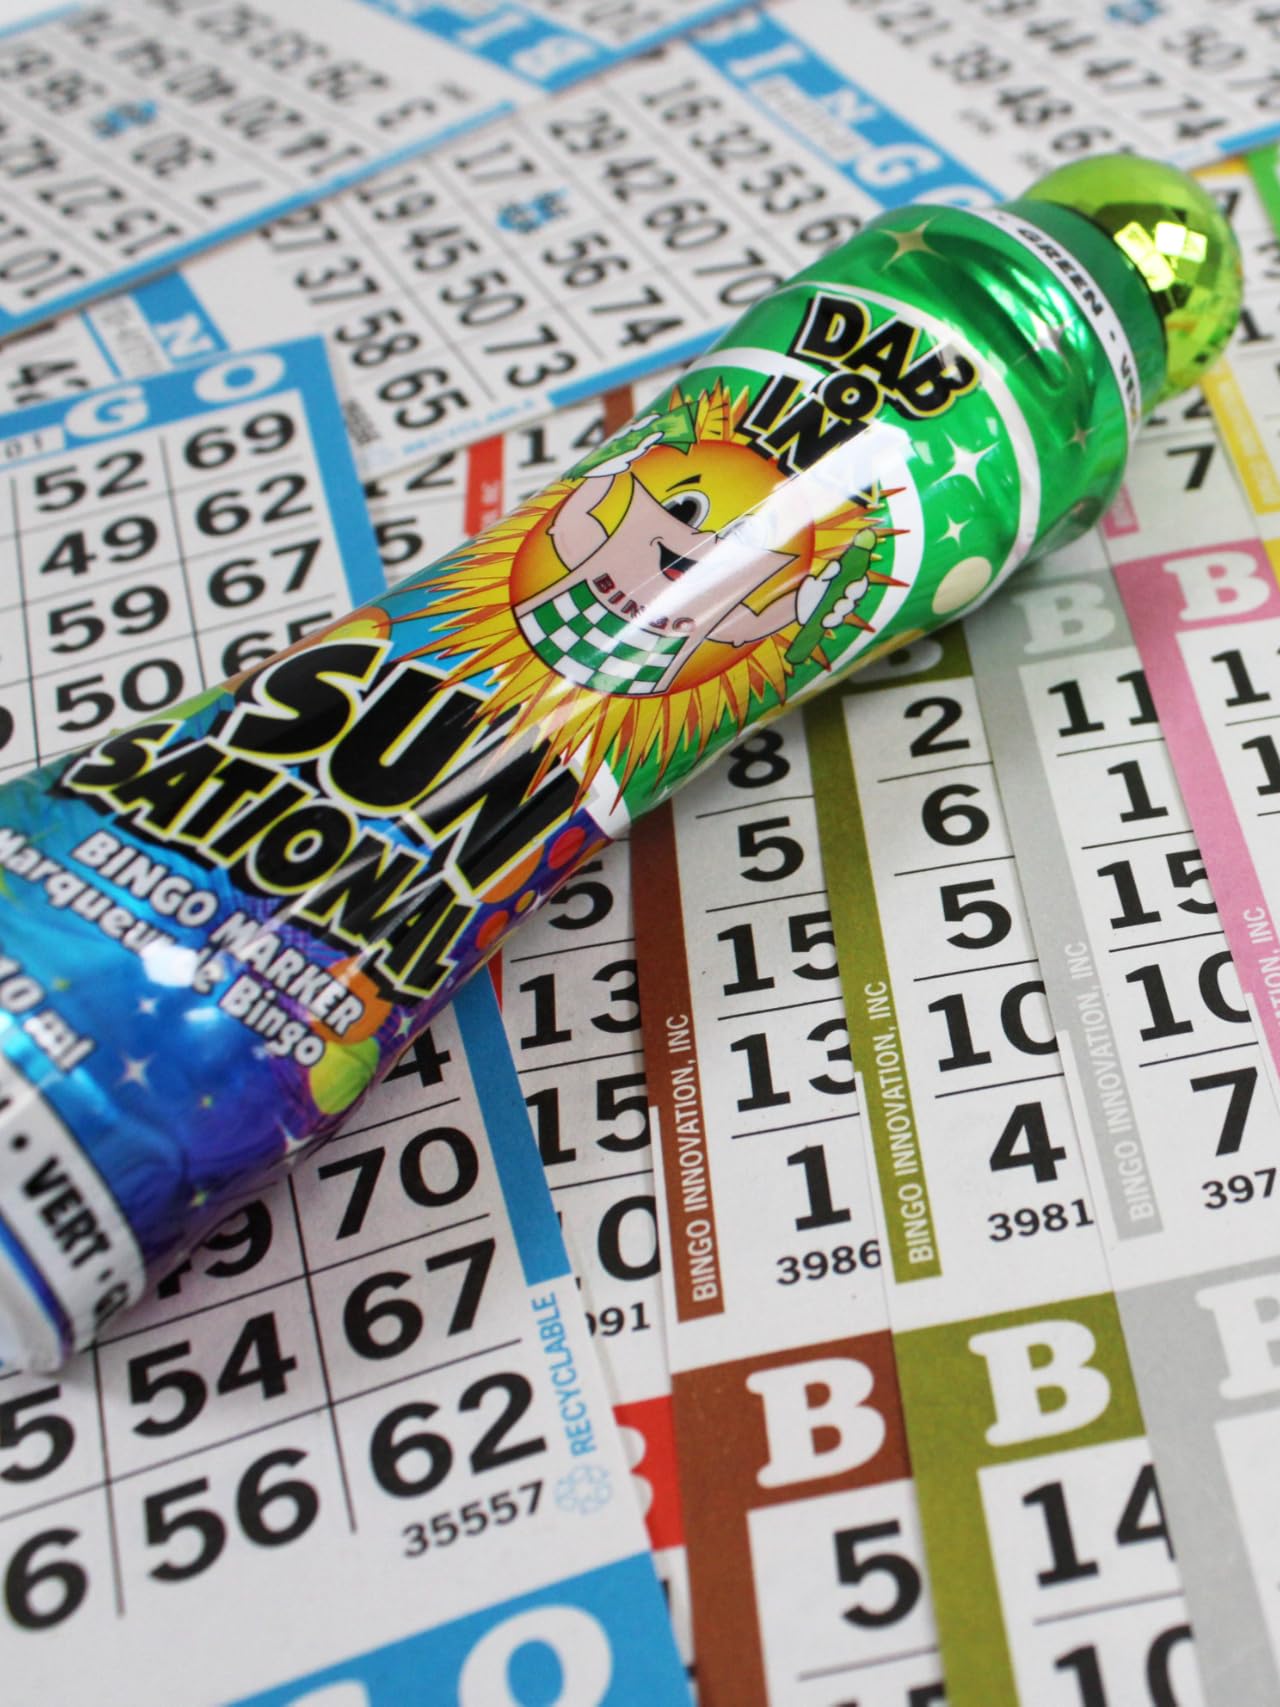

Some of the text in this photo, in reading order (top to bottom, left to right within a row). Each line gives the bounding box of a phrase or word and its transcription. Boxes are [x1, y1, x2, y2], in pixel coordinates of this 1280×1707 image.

[295, 255, 381, 305] 37
[335, 162, 826, 370] 58 50 56 53
[1017, 227, 1106, 317] GREEN
[377, 368, 470, 429] 65
[483, 324, 578, 389] 73
[589, 286, 685, 349] 74
[790, 291, 980, 420] DAB
[33, 450, 150, 514] 52
[182, 411, 296, 471] 69
[39, 474, 314, 576] 49 62
[47, 538, 322, 655] 59 67
[1162, 551, 1271, 621] B
[55, 657, 185, 734] 50
[902, 696, 971, 758] 2
[218, 638, 590, 899] SUN
[921, 783, 989, 847] 6
[1107, 760, 1169, 823] 1
[57, 718, 479, 998] SATIONAL
[737, 817, 805, 882] 5
[70, 830, 366, 1037] BINGO MARKER
[940, 878, 1013, 951] 5
[1244, 906, 1273, 944] INC
[218, 974, 327, 1067] Bingo
[864, 981, 933, 1264] BINGO INNOVATION, INC
[1064, 941, 1151, 1222] BINGO INNOVATION, INC
[1190, 1065, 1259, 1157] 7
[318, 1127, 480, 1240] 70
[666, 1013, 717, 1302] BINGO INNOVATION, INC
[787, 1144, 851, 1231] 1
[988, 1101, 1067, 1185] 4
[23, 1155, 110, 1270] VERT
[776, 1240, 881, 1285] 3986
[987, 1198, 1096, 1244] 3981
[342, 1237, 497, 1363] 67
[127, 1312, 548, 1498] 54 62
[531, 1292, 598, 1457] RECYCLABLE
[746, 1357, 886, 1489] B
[967, 1318, 1112, 1448] B
[143, 1448, 320, 1583] 56
[402, 1479, 546, 1558] 35557
[833, 1519, 922, 1629] 5
